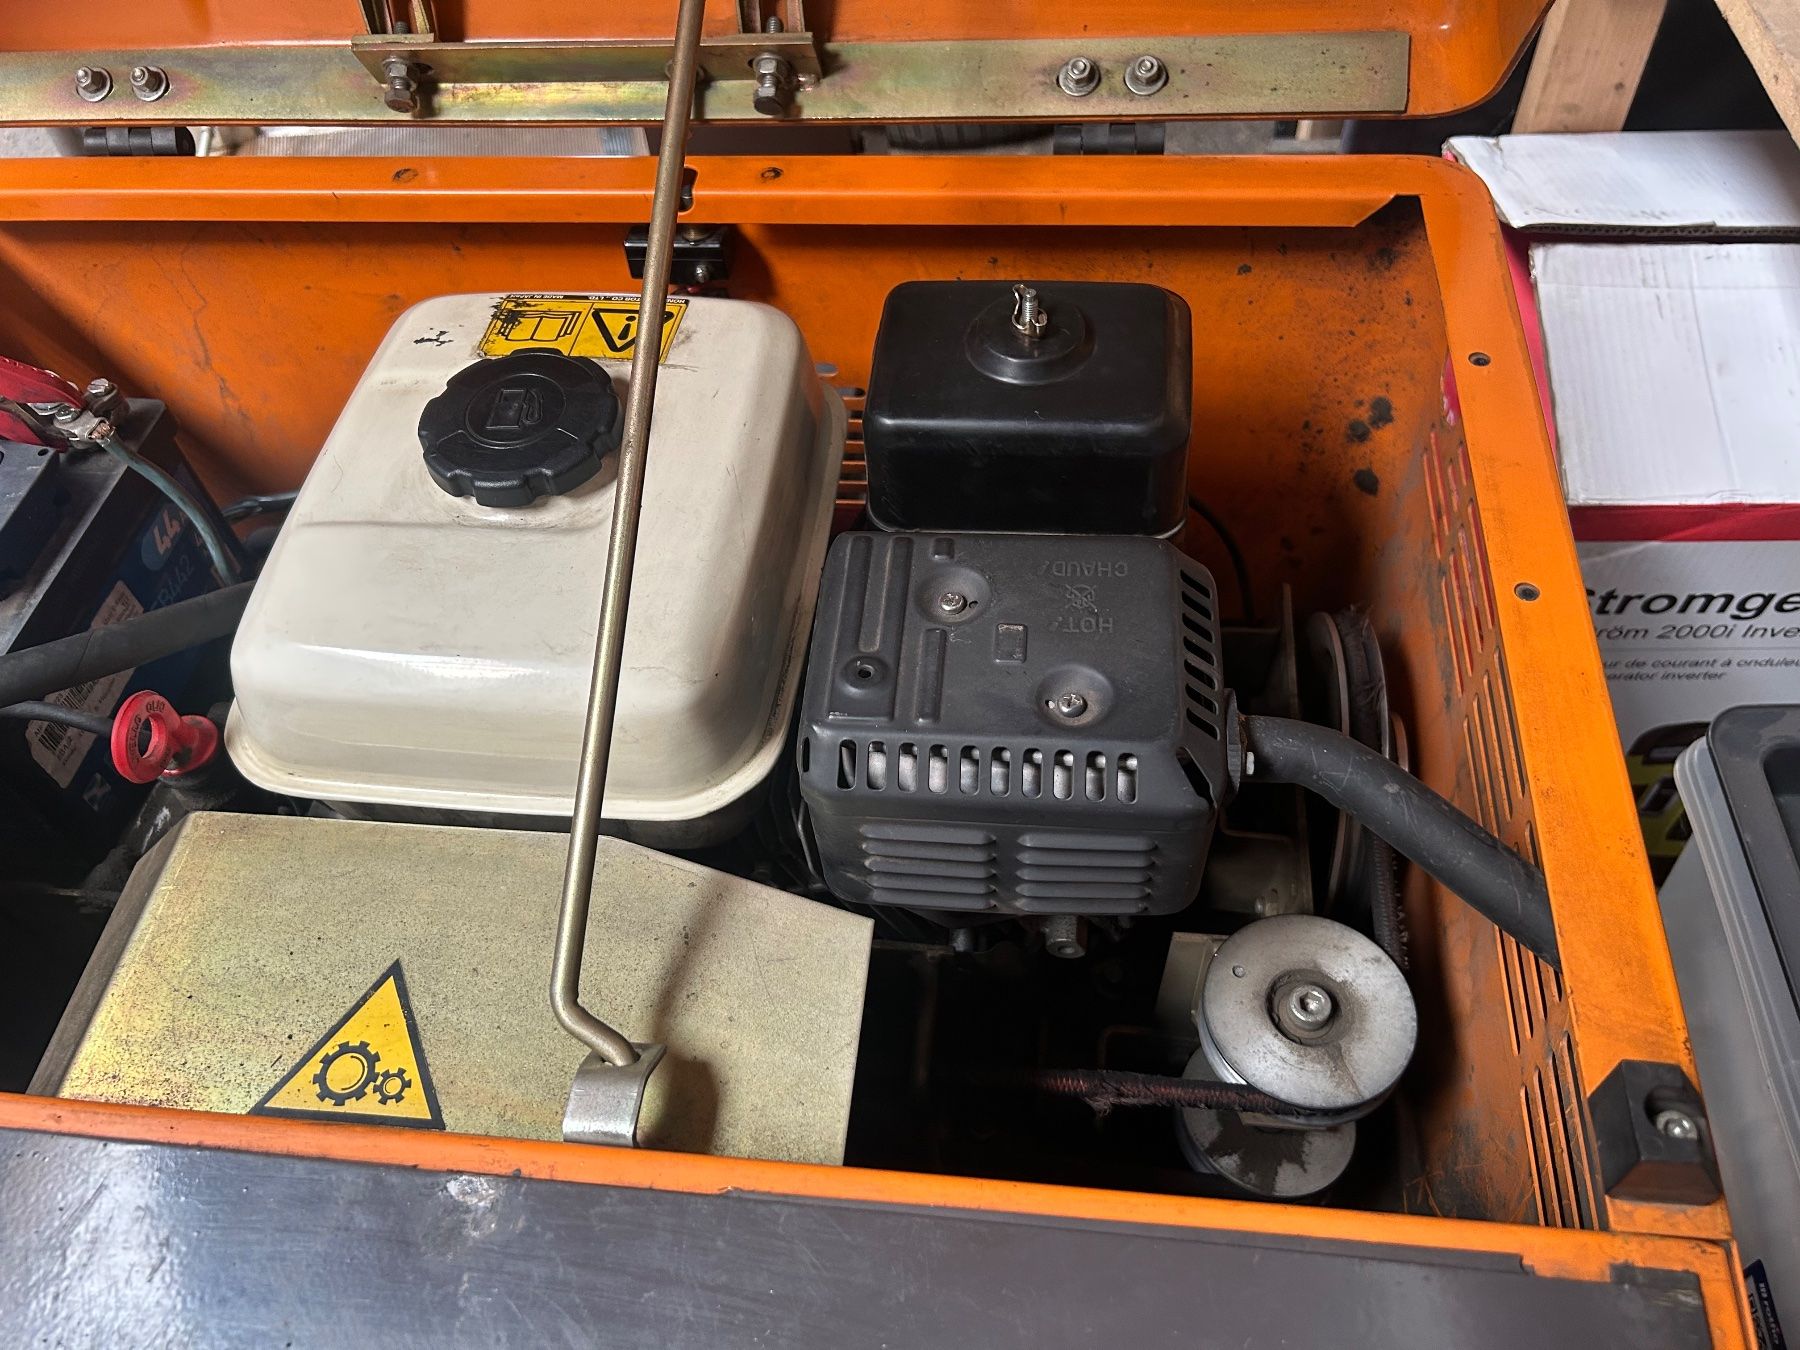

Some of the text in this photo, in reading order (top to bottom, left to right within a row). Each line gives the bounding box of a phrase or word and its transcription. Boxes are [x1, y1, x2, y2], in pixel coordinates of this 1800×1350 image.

[1037, 560, 1129, 578] CHAUD!
[1048, 616, 1114, 634] HOT!
[1596, 624, 1800, 640] röm 2000i Inve
[1625, 658, 1647, 669] de
[1651, 658, 1717, 669] courant
[1660, 670, 1727, 682] inverter
